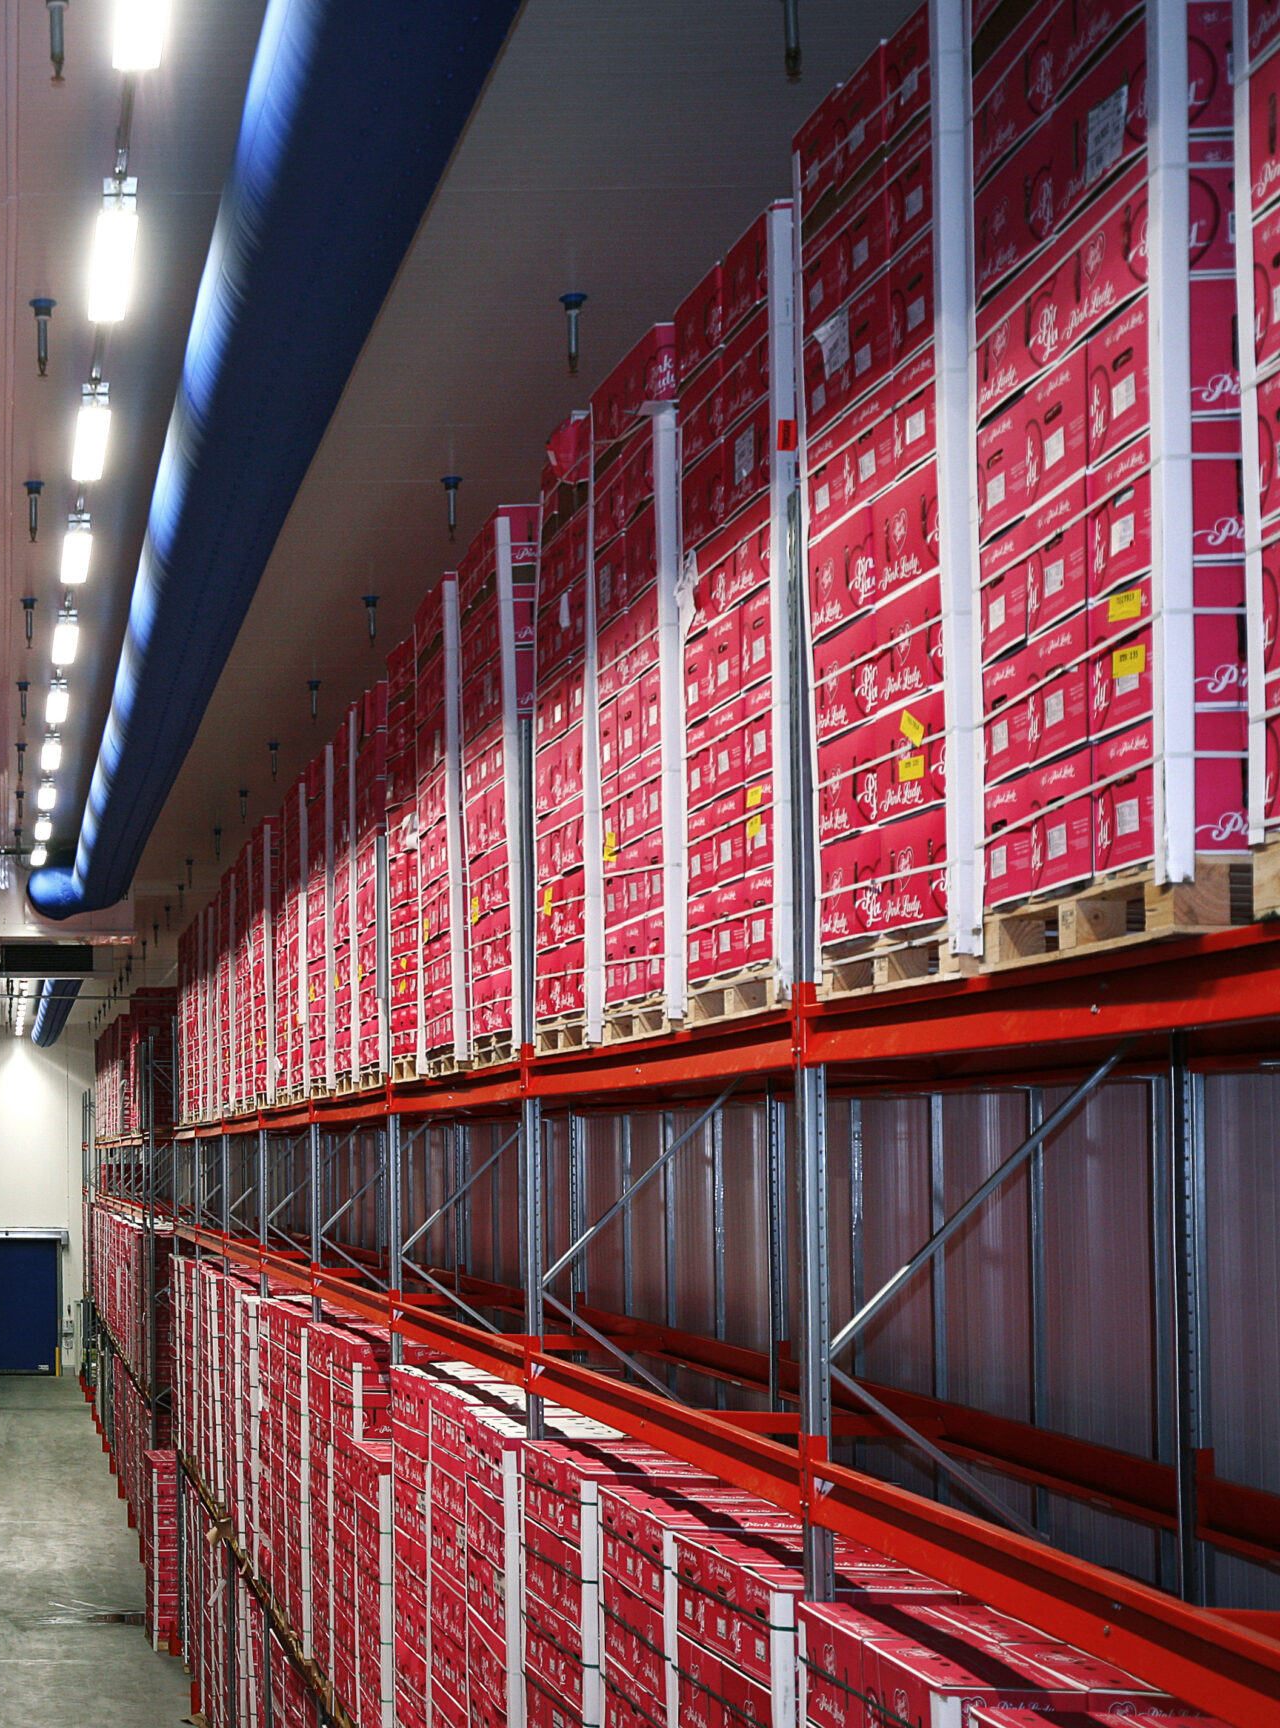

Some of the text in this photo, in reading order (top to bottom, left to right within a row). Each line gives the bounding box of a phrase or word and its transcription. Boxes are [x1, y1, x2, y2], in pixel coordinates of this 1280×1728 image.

[878, 553, 923, 590] Pink Lady
[881, 665, 924, 701] Pink Lady
[880, 780, 925, 813] Pink Lady
[882, 894, 925, 923] Pink Lady
